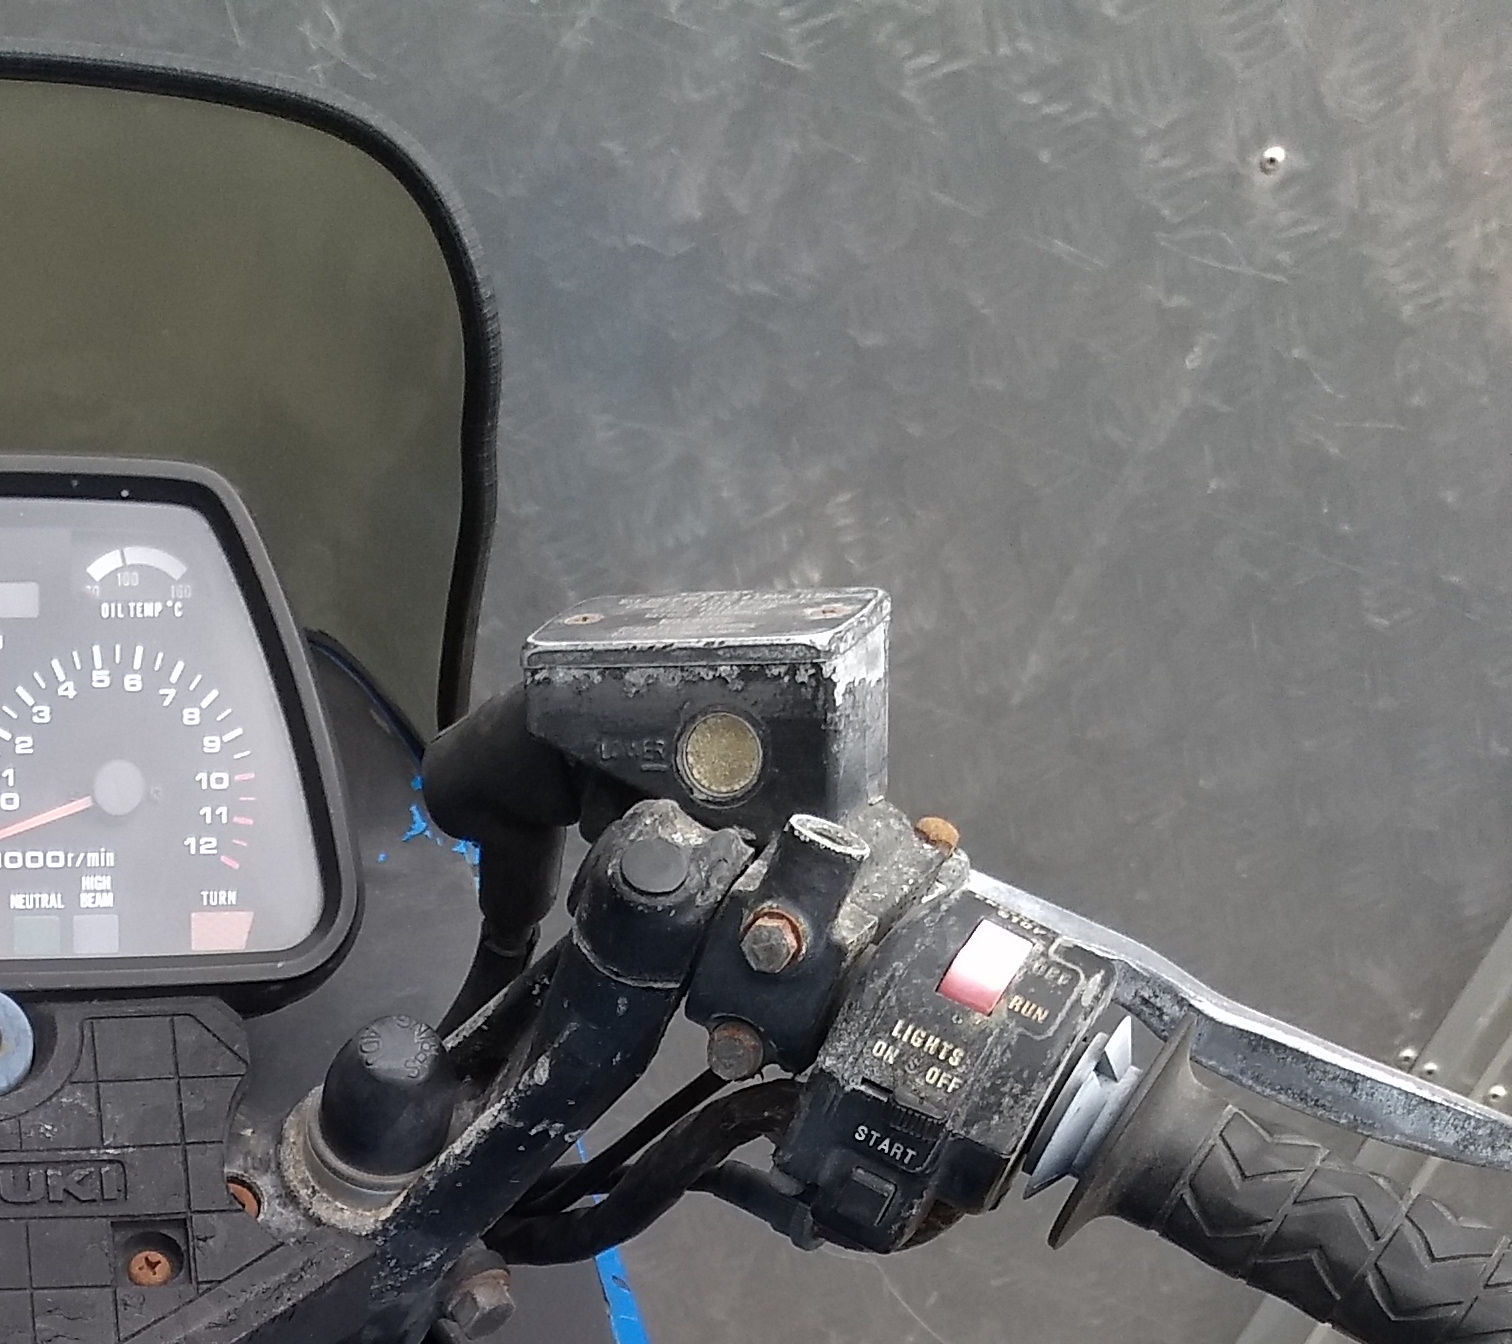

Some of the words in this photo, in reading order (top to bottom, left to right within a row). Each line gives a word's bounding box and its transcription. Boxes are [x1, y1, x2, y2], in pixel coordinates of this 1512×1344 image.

[116, 572, 140, 587] 100
[101, 602, 125, 619] OIL
[128, 602, 163, 618] TEMP
[91, 670, 111, 688] 5
[123, 674, 143, 692] 6
[57, 681, 77, 699] 4
[158, 689, 177, 706] 7
[32, 705, 51, 724] 3
[182, 708, 201, 725] 8
[14, 736, 34, 754] 2
[203, 735, 221, 754] 9
[2, 769, 15, 787] 1
[195, 772, 230, 790] 10
[0, 792, 20, 811] 0
[199, 806, 228, 824] 11
[183, 837, 217, 855] 12
[81, 875, 111, 891] HIGH
[10, 893, 65, 910] NEUTRAL
[80, 892, 114, 909] BEAM
[201, 891, 237, 906] TURN
[1008, 995, 1050, 1024] RUN
[891, 1019, 965, 1067] LIGHTS
[872, 1040, 900, 1065] ON
[925, 1067, 964, 1093] OFF
[854, 1125, 917, 1165] START
